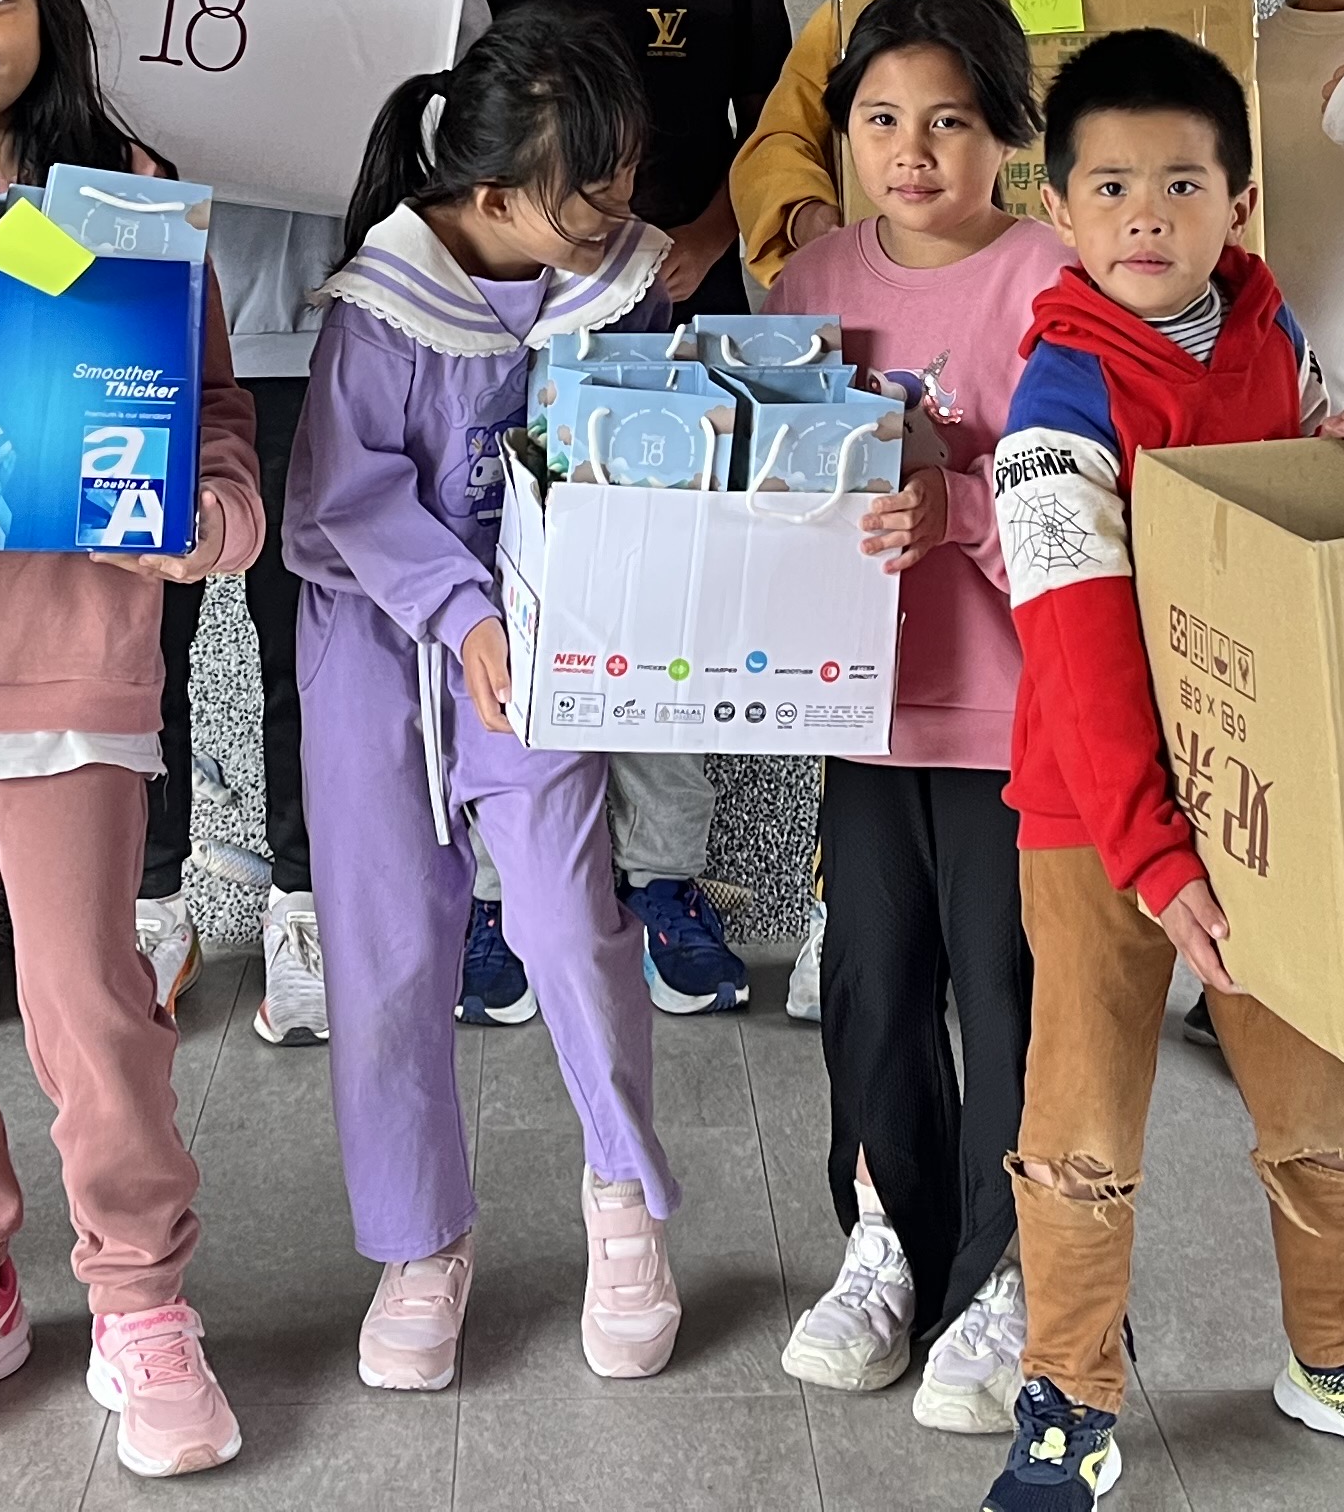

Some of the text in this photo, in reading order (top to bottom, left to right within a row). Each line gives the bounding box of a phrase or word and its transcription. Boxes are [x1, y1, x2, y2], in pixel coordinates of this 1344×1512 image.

[72, 363, 163, 382] Smoother
[104, 381, 180, 399] Thicker
[93, 478, 150, 490] Double A
[554, 653, 597, 667] NEW!
